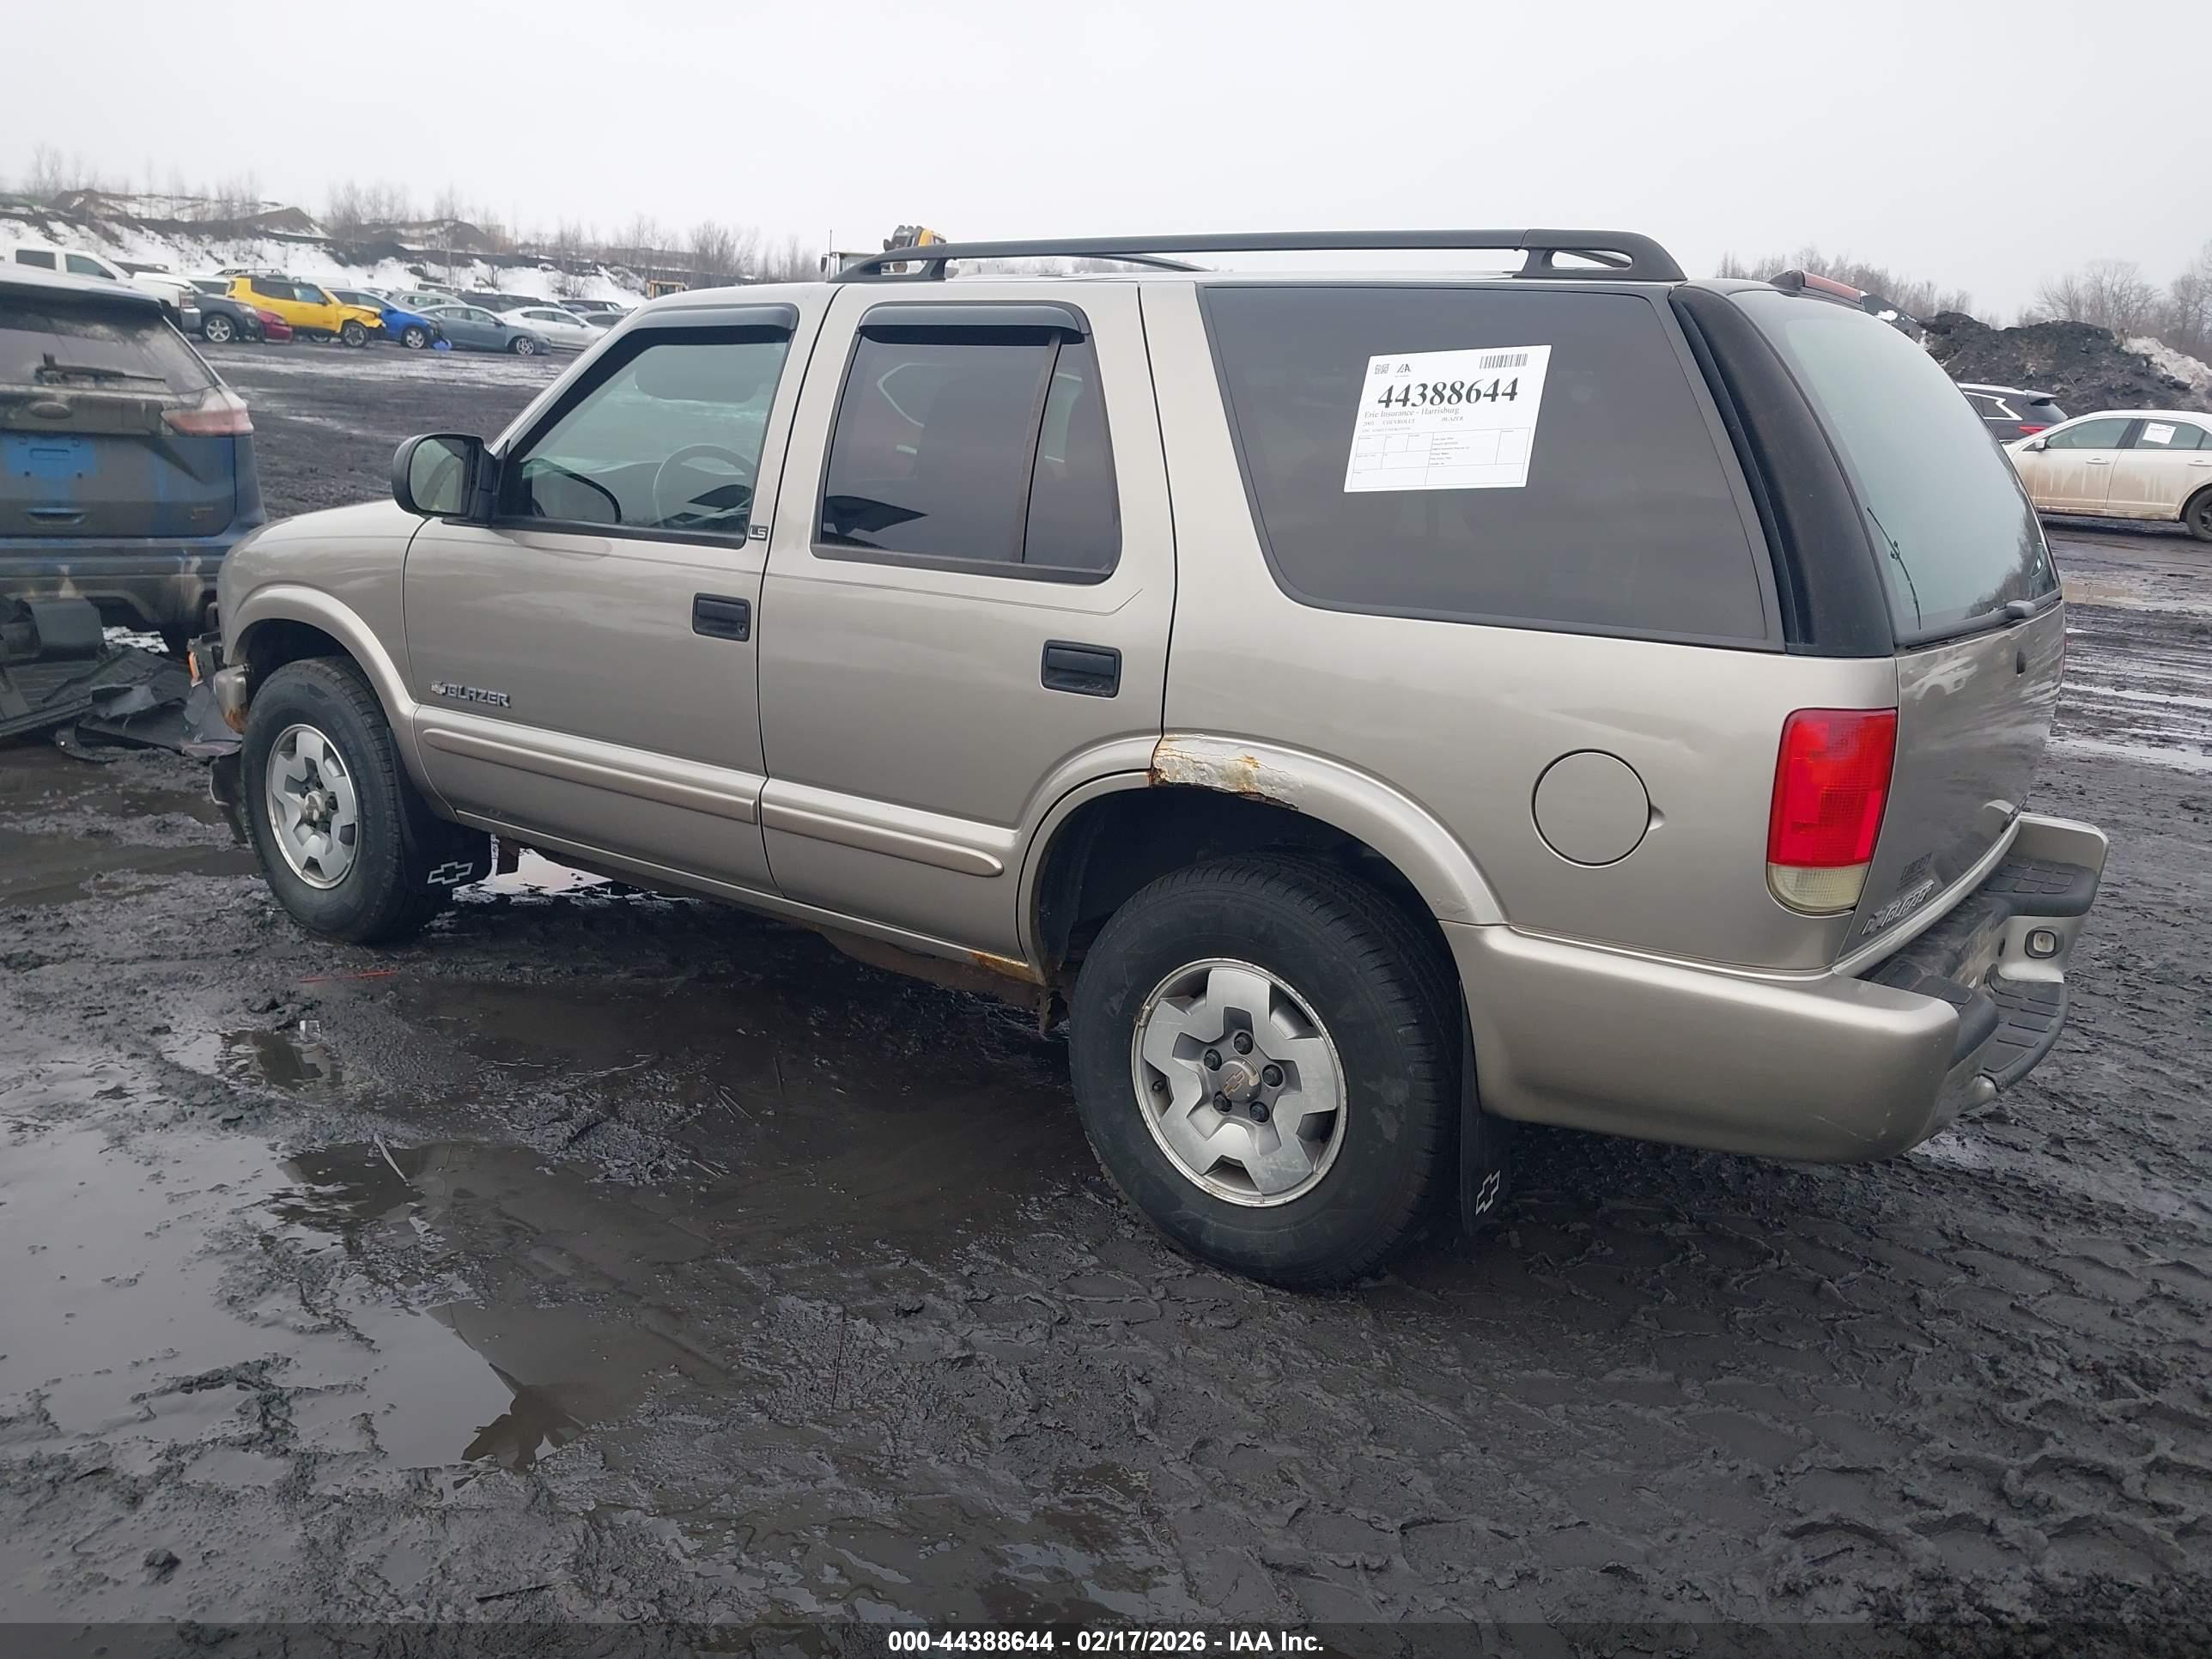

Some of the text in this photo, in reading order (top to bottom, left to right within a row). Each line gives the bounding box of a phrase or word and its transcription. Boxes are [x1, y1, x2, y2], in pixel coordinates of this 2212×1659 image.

[1377, 377, 1519, 409] 44388644
[1381, 409, 1414, 418] Insurance
[1421, 406, 1460, 416] Harrisburg
[750, 526, 767, 538] LS
[447, 684, 510, 708] BLAZER
